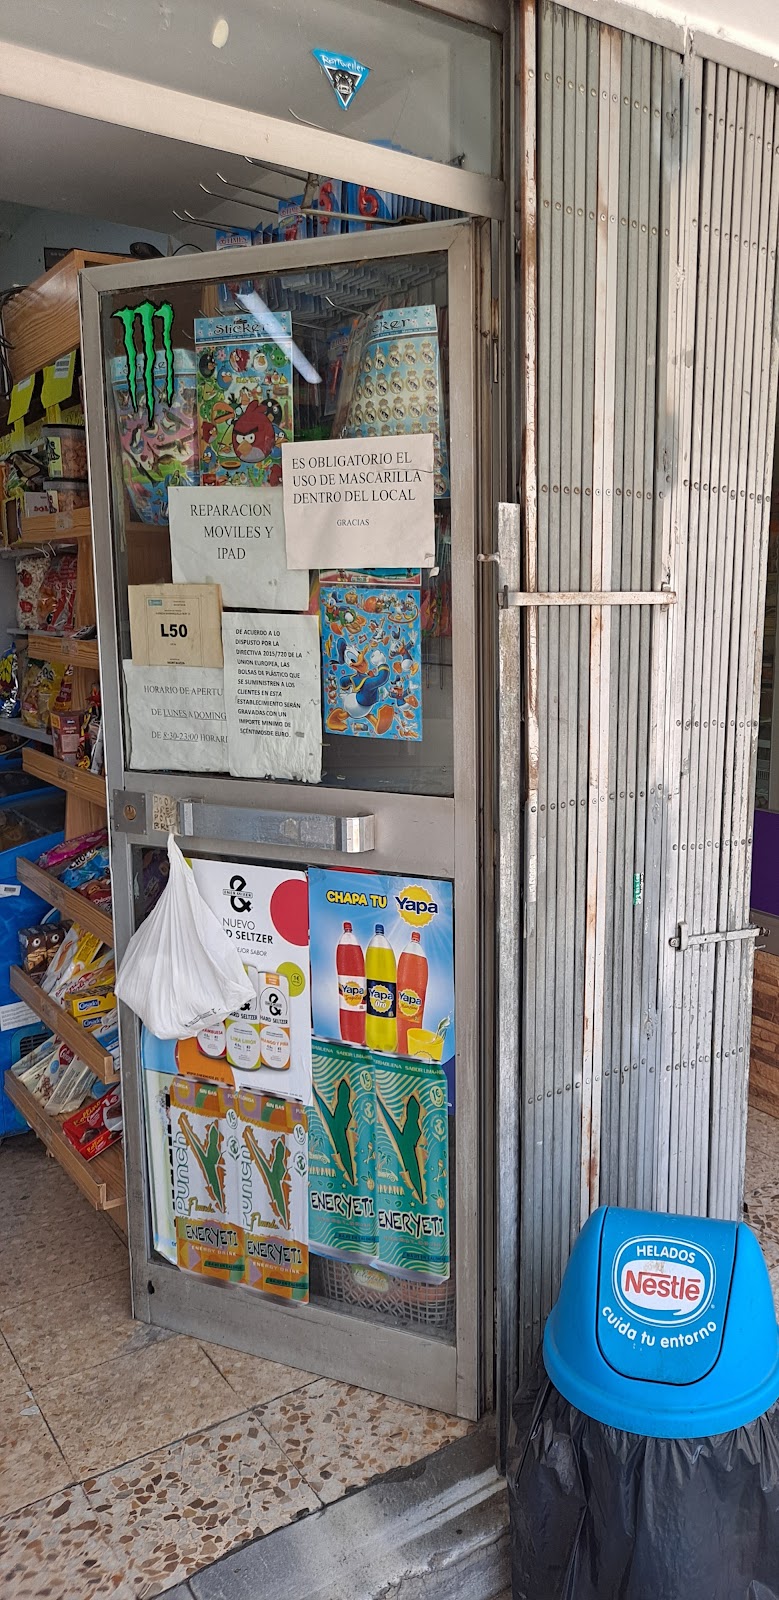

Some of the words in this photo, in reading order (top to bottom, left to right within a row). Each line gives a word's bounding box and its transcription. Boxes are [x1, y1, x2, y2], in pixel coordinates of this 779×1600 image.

[292, 458, 306, 470] ES
[308, 452, 392, 468] OBLIGATORIO
[396, 452, 412, 464] EL
[293, 475, 316, 487] USO
[320, 474, 336, 486] DE
[340, 471, 422, 485] MASCARILLA
[294, 491, 342, 504] DENTRO
[344, 490, 369, 502] DEL
[372, 489, 416, 502] LOCAL
[190, 504, 272, 516] REPARACION
[336, 518, 370, 526] GRACIAS
[204, 526, 260, 538] MOVILES
[264, 526, 274, 538] Y
[217, 548, 246, 560] IPAD
[160, 624, 188, 638] L50
[144, 685, 178, 694] HORARIO
[237, 699, 283, 707] ESTABLECIMIENTO
[163, 708, 188, 718] LUNES
[194, 711, 226, 721] DOMING
[163, 732, 198, 742] 8:30-23:00
[326, 890, 368, 906] CHAPA
[370, 895, 388, 910] TU
[395, 896, 438, 915] Yapa
[222, 918, 256, 930] NUEVO
[236, 930, 274, 944] SELTZER
[250, 948, 268, 956] SABOR
[342, 984, 364, 996] Yapa
[368, 988, 394, 1000] Yapa
[375, 1000, 386, 1008] Oro
[399, 991, 422, 1006] Yapa
[311, 1192, 374, 1218] ENERYETI
[378, 1210, 444, 1238] ENERYETI
[186, 1226, 238, 1248] ENERYETI
[192, 1245, 216, 1254] ENERGY
[248, 1240, 302, 1264] ENERYETI
[636, 1245, 696, 1264] HELADOS
[252, 1261, 278, 1270] ENERGY
[602, 1306, 637, 1340] cuida
[641, 1331, 656, 1346] tu
[660, 1321, 716, 1348] entorno
